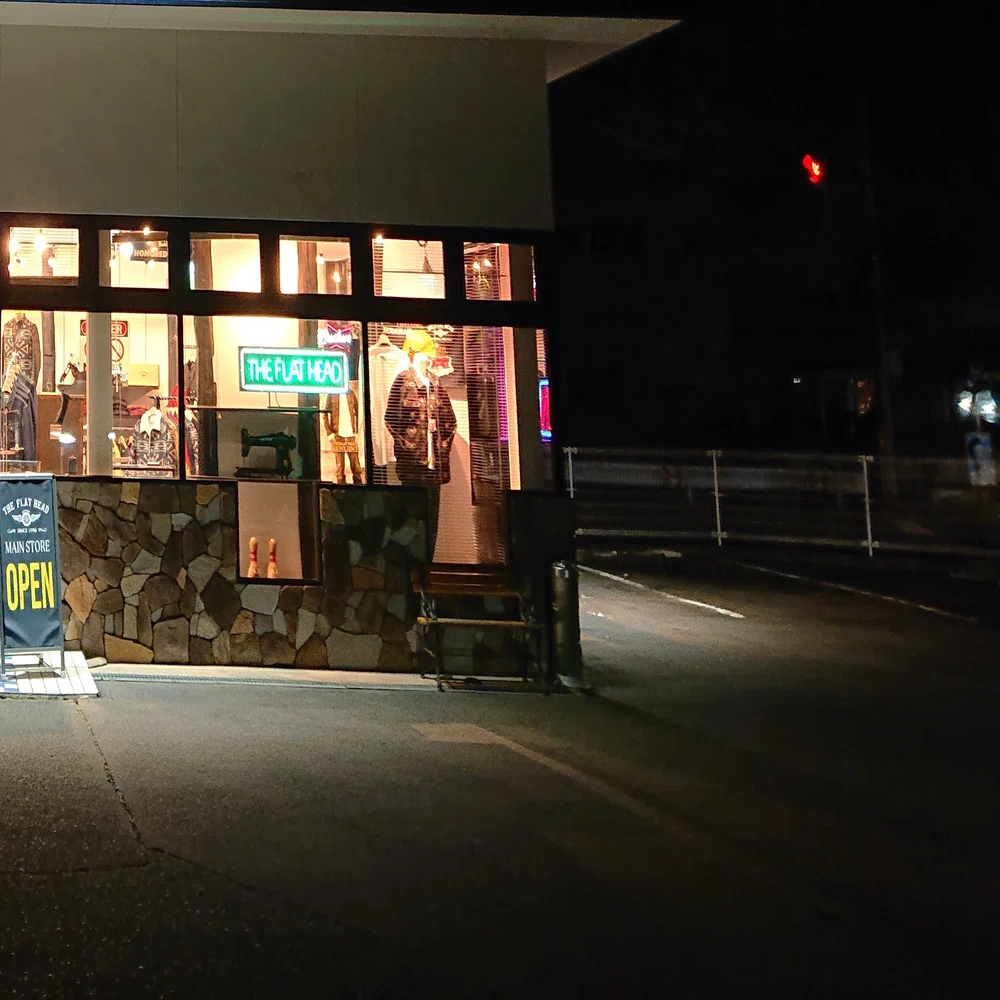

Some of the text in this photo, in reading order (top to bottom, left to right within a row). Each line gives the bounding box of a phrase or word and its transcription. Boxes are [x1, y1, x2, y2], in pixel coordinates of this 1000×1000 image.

[247, 357, 343, 384] THE FLAT HEAD
[2, 497, 50, 516] THE FLAT HEAD
[4, 539, 51, 554] MAIN STORE
[5, 561, 55, 611] OPEN
